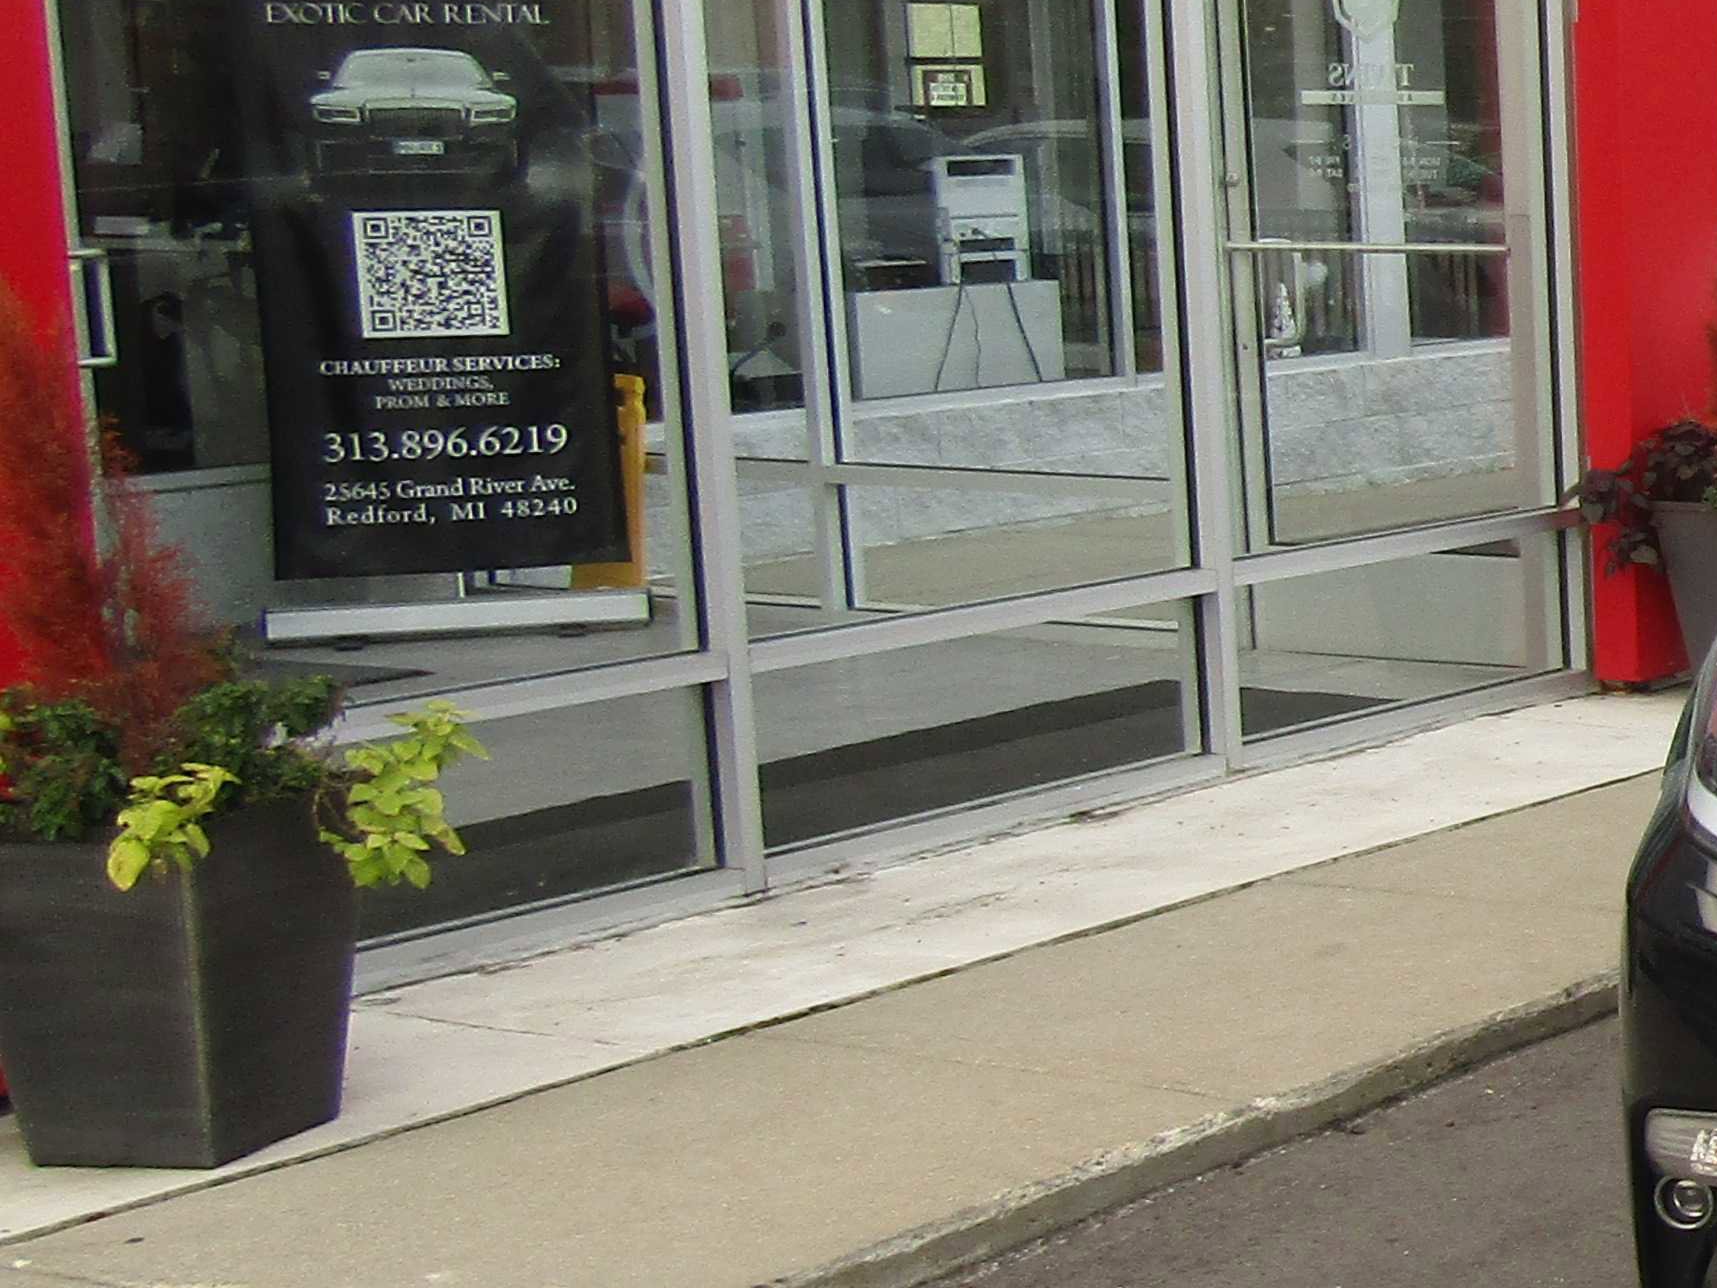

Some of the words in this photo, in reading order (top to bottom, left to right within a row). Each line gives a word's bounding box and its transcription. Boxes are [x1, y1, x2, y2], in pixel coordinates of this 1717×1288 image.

[265, 3, 368, 24] EXOTIC
[374, 3, 434, 25] CAR
[445, 3, 551, 24] RENTAL
[319, 358, 449, 376] CHAUFFEUR
[453, 354, 561, 373] SERVICES:
[388, 376, 494, 392] WEDDINGS,
[376, 395, 429, 409] PROM
[436, 393, 451, 408] &
[456, 392, 511, 407] MORE
[324, 423, 568, 463] 313.896.6219
[324, 481, 391, 501] 25645
[396, 478, 463, 499] Grand
[469, 476, 525, 496] River
[531, 474, 576, 492] Ave.
[326, 503, 436, 526] Redford,
[452, 502, 487, 521] MI
[501, 496, 578, 519] 48240
